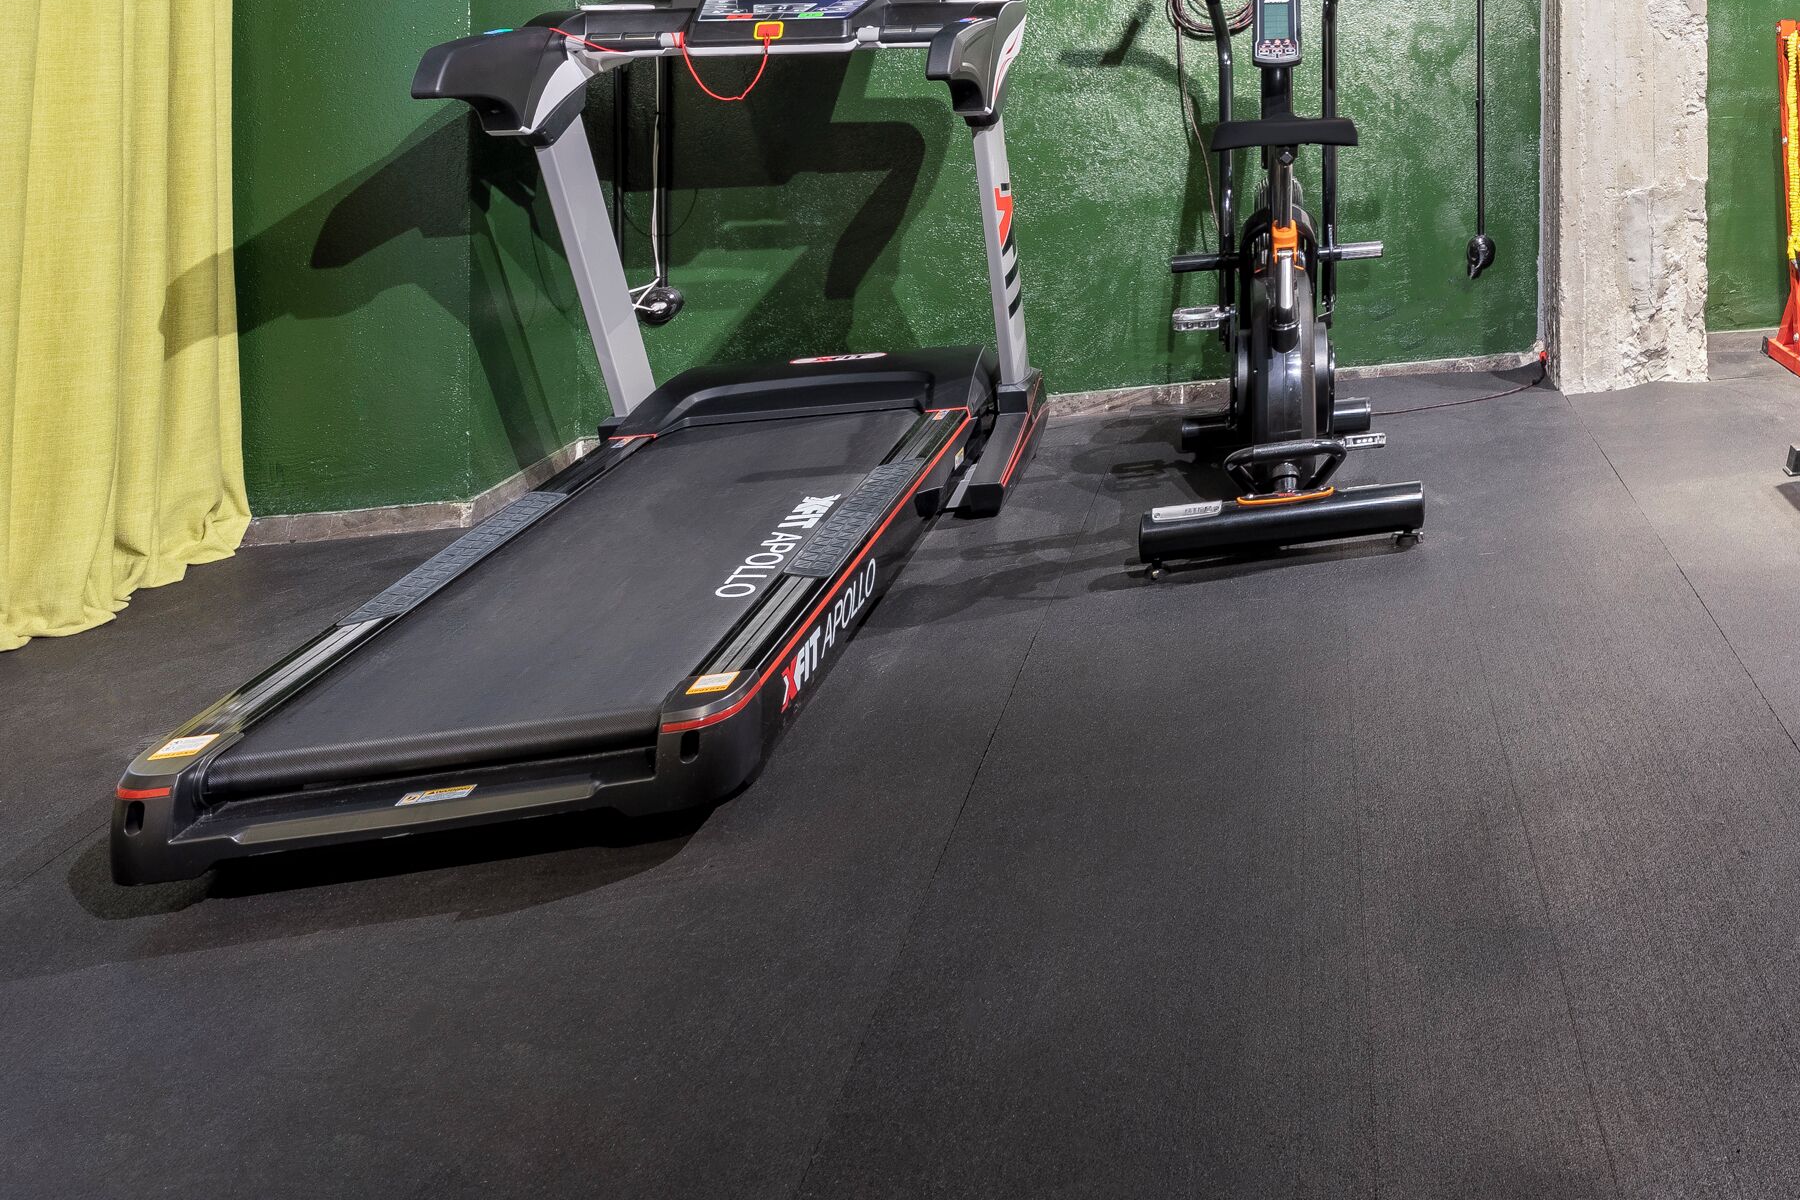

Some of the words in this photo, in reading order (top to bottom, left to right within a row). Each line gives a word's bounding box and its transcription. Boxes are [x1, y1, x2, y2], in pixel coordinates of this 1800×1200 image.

[777, 493, 842, 530] XFIT
[715, 531, 803, 598] APOLLO
[781, 627, 821, 714] XFIT
[821, 558, 877, 660] APOLLO
